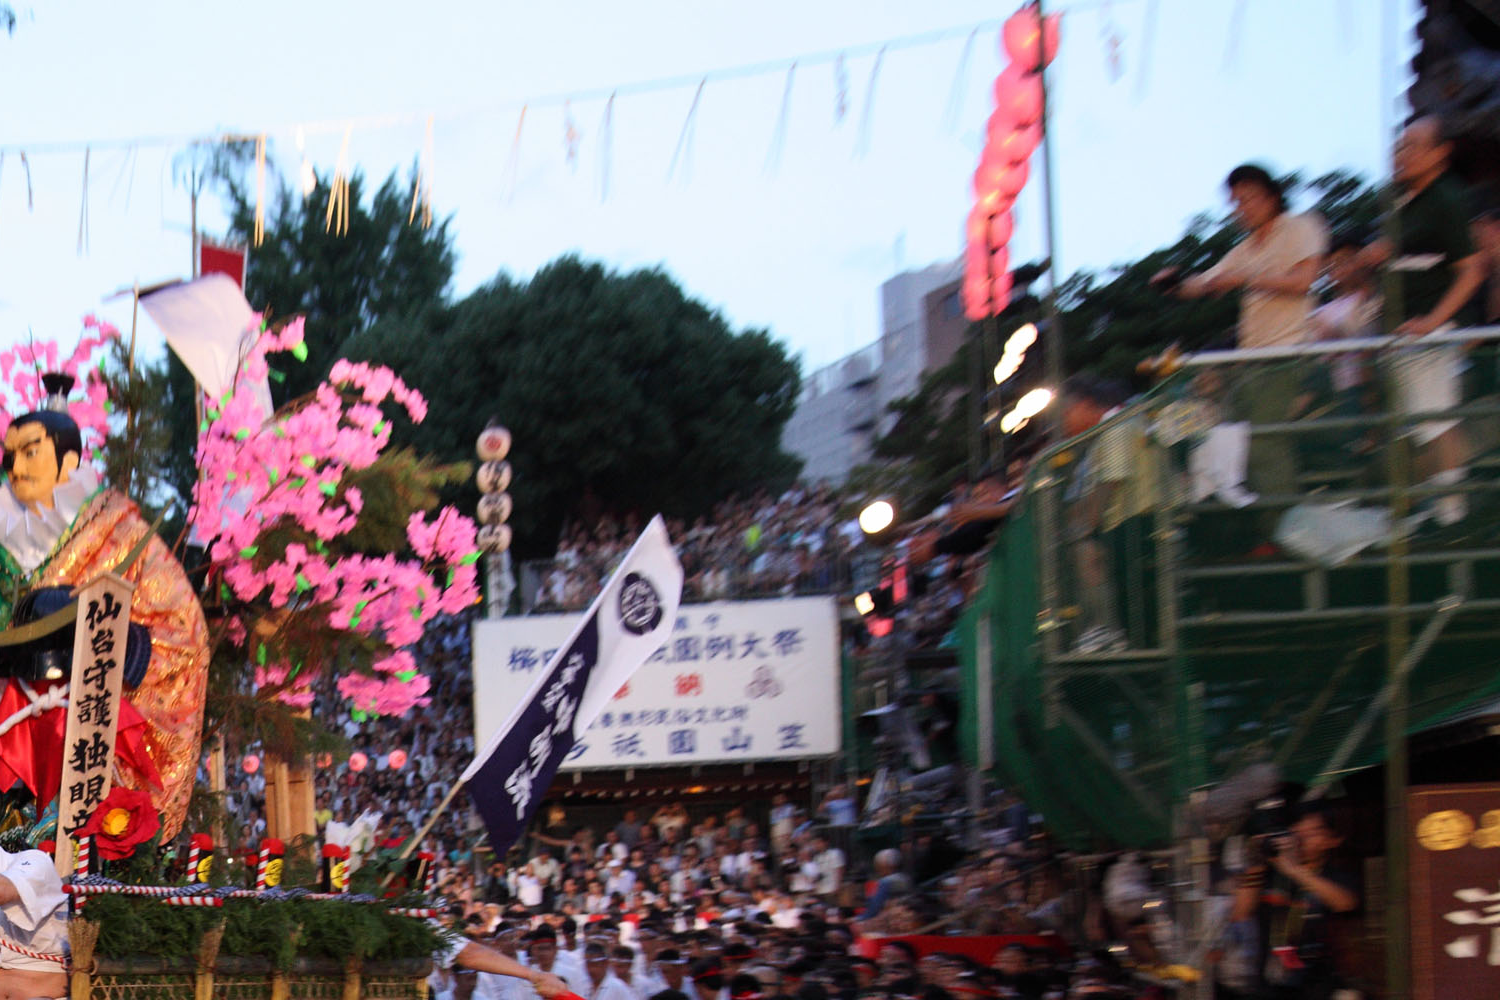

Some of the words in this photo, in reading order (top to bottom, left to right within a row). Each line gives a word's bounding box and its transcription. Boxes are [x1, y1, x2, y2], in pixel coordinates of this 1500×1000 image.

[587, 704, 749, 731] 要無形民俗文化財
